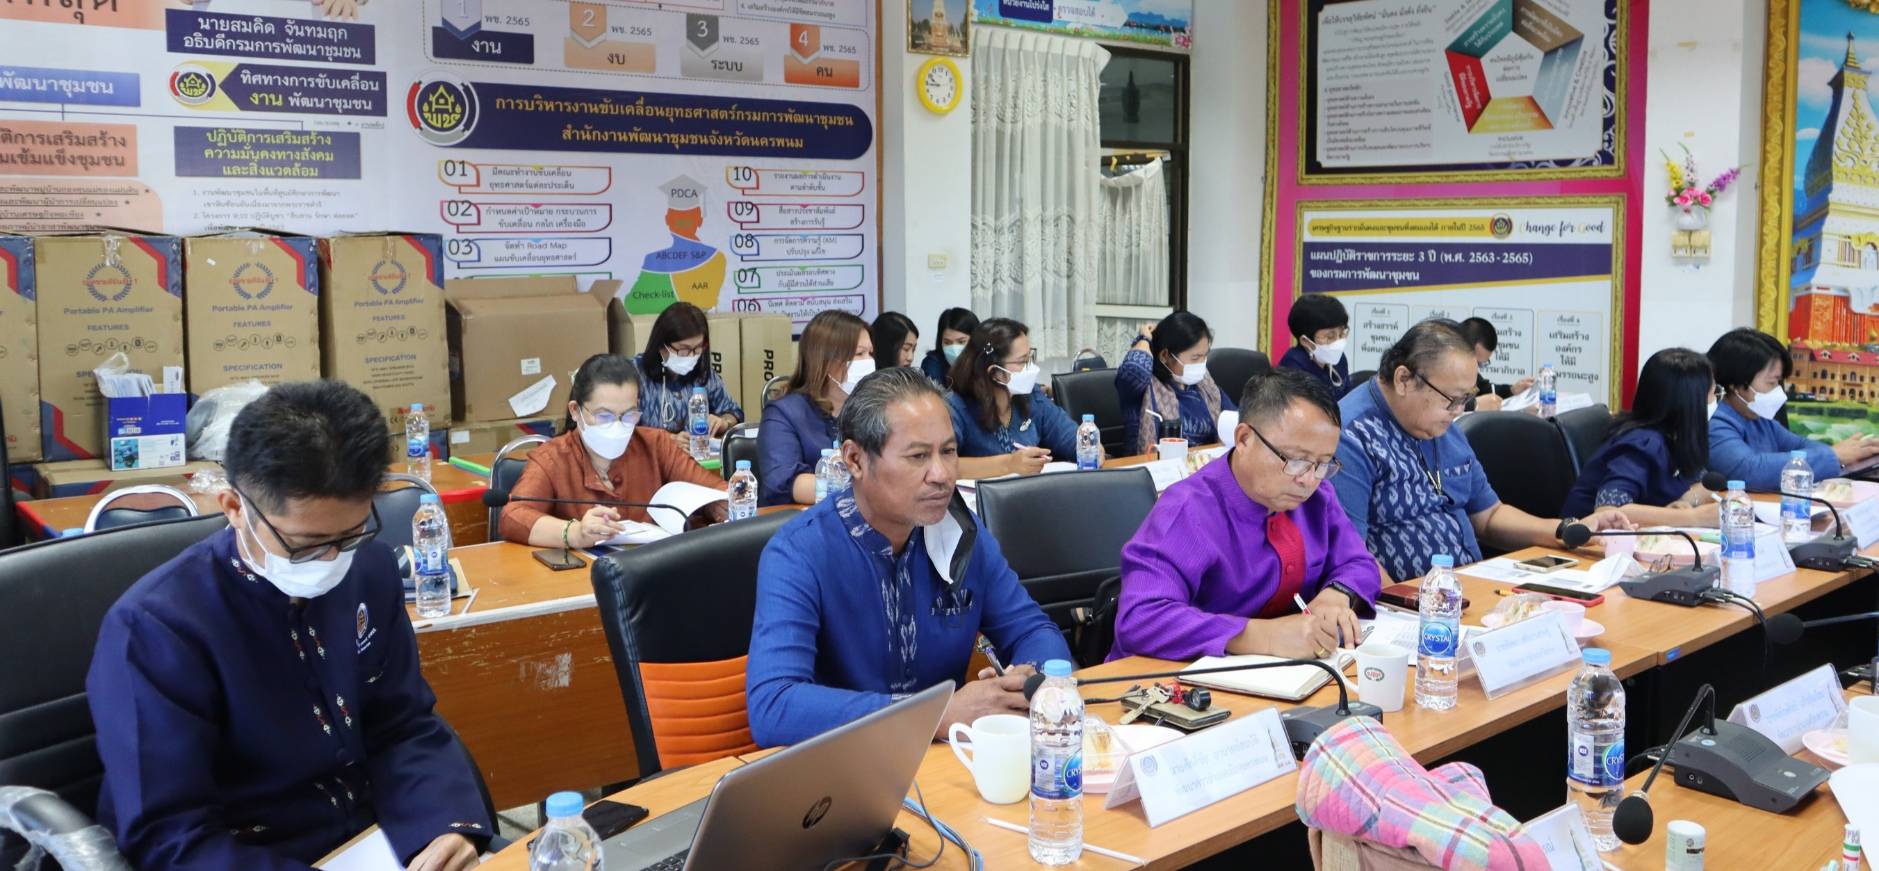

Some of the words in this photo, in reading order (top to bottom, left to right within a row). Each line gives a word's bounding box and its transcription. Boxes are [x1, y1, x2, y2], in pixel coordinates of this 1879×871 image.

[506, 16, 531, 26] 2565
[582, 9, 596, 28] 2
[198, 16, 275, 36] นายสมคิด
[284, 19, 348, 42] จันทมฤก
[630, 27, 653, 36] 2565
[696, 20, 709, 38] 3
[739, 36, 760, 46] 2565
[797, 30, 809, 47] 4
[183, 33, 362, 62] อธิบดีกรมการพัฒนาชุมชน
[471, 40, 502, 55] งาน
[838, 45, 857, 55] 2565
[607, 52, 626, 66] งบ
[710, 58, 744, 73] ระบบ
[816, 66, 833, 78] คน
[0, 71, 114, 98] พัฒนาชุมชน
[239, 68, 380, 92] ทิศทางการขับเคลื่อน
[249, 92, 284, 107] งาน
[287, 91, 373, 113] พัฒนาชุมชน
[495, 94, 854, 129] การบริหารงานขับเคลื่อนยุทธศาสตร์กรมการพัฒนาชุมชน
[205, 127, 332, 147] ปฏิบัติการเสริมสร้าง
[562, 123, 804, 150] สำนักงานพัฒนาชุมชนจังหวัดนครพนม
[204, 144, 335, 162] ความมั่นคงทางสังคม
[222, 160, 319, 178] และสิ่งแวดล้อม
[444, 160, 468, 177] 01
[733, 166, 752, 182] 10
[671, 188, 698, 199] PDCA
[447, 200, 473, 217] 02
[734, 201, 754, 216] 09
[1559, 220, 1574, 237] for
[448, 238, 473, 255] 03
[527, 242, 548, 250] Road
[549, 242, 568, 251] Map
[734, 233, 754, 249] 08
[656, 251, 688, 260] ABCDEF
[1309, 248, 1415, 264] แผนปฏิบัติราชการระยะ
[1418, 251, 1425, 262] 3
[1428, 249, 1437, 262] ปี
[1440, 251, 1465, 265] (พ.ศ.
[738, 268, 757, 283] 07
[1309, 267, 1420, 285] ของกรมการพัฒนาชุมชน
[691, 281, 709, 290] AAR
[212, 305, 245, 313] Portable
[259, 304, 293, 313] Amplifier
[354, 299, 382, 307] Portable
[395, 298, 424, 306] Amplifier
[64, 306, 100, 315] Portable
[117, 306, 154, 315] Amplifier
[372, 314, 406, 322] FEATURES
[233, 320, 272, 328] FEATURES
[1370, 333, 1391, 345] ชุมชน
[1548, 331, 1590, 342] เสริมสร้าง
[1555, 343, 1582, 354] องค์กร
[365, 354, 416, 364] SPECIFICATION
[1560, 354, 1577, 367] ให้มี
[224, 363, 283, 372] SPECIFICATION
[1555, 370, 1600, 384] มรรถนะสูง
[1423, 633, 1451, 643] CRYSTAL
